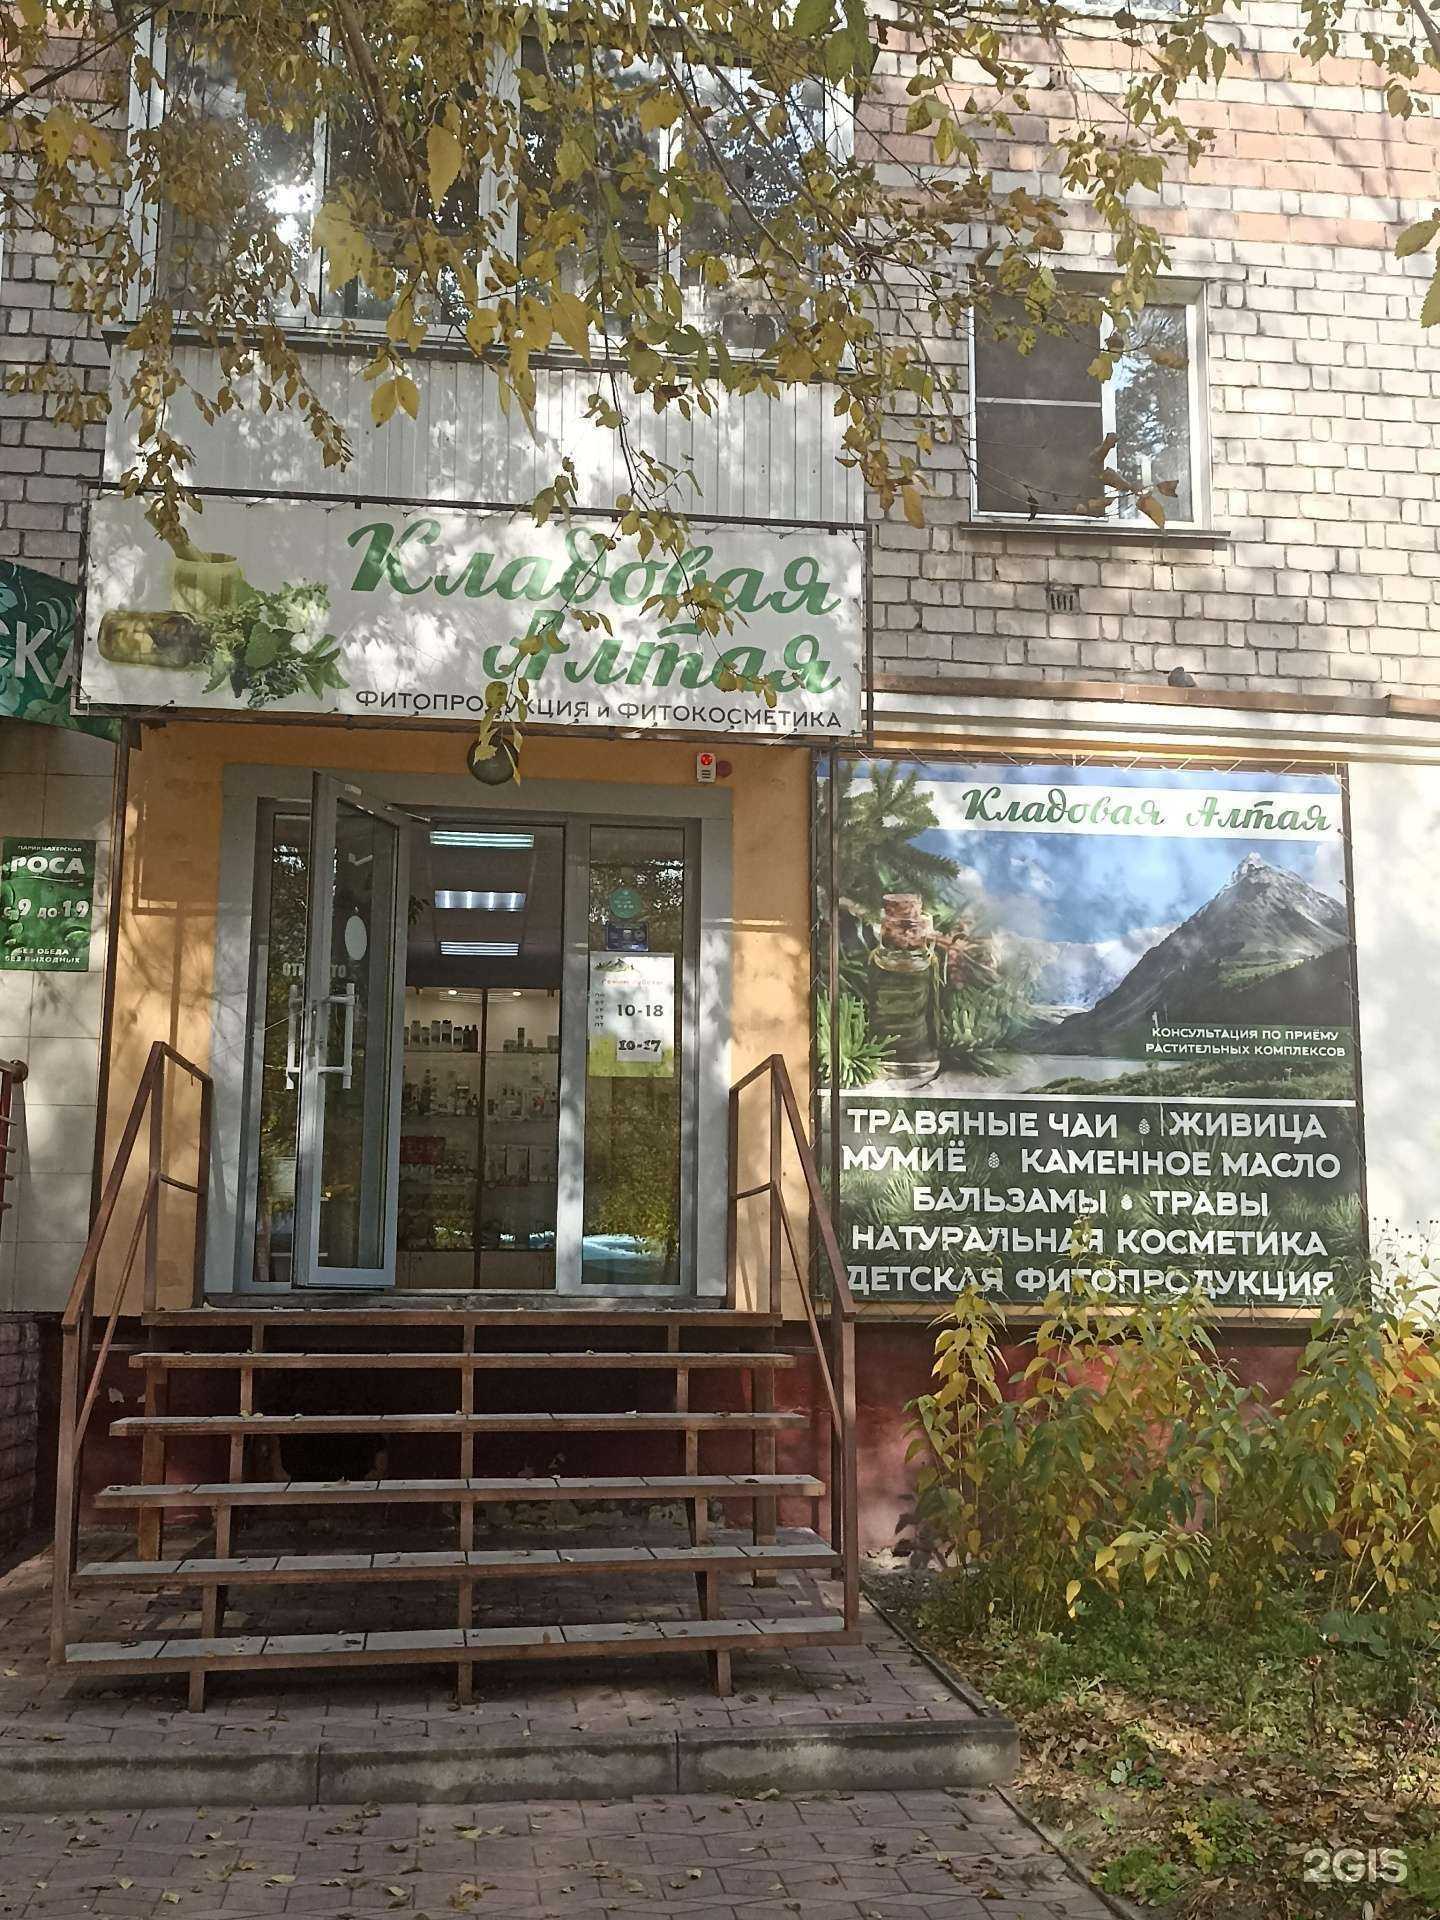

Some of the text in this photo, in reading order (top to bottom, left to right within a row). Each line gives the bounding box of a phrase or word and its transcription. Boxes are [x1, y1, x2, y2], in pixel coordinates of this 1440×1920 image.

[347, 518, 841, 616] Кладовая
[482, 609, 841, 694] Алтая
[356, 690, 589, 719] ФИТОПРОУКЦИЯ
[618, 703, 842, 728] ФИТОКОСМЕТИКА
[962, 788, 1332, 832] Кладовая Алтая
[11, 856, 85, 874] РОСА
[18, 898, 32, 916] 9
[63, 900, 90, 918] 19
[617, 1004, 664, 1017] 10-18
[618, 1039, 662, 1053] 10-17
[1146, 1043, 1347, 1057] РАСТИТЕЛЬНЫХ КОМПЛЕКСОВ
[1152, 1027, 1339, 1042] КОНСУЛЬТАЦИЯ ПО ПРИЁМУ
[847, 1108, 1327, 1144] ТРАВЯНЫЕ ЧАИ ЖИВИЦА
[842, 1140, 1341, 1179] МУМИЁ КАМЕННОЕ МАСЛО
[913, 1186, 1268, 1218] БАЛЬЗАМЫ ТРАВЫ
[852, 1225, 1328, 1257] НАТУРАЛЬНАЯ КОСМЕТИКА
[847, 1265, 1004, 1295] ДЕТСКАЯ
